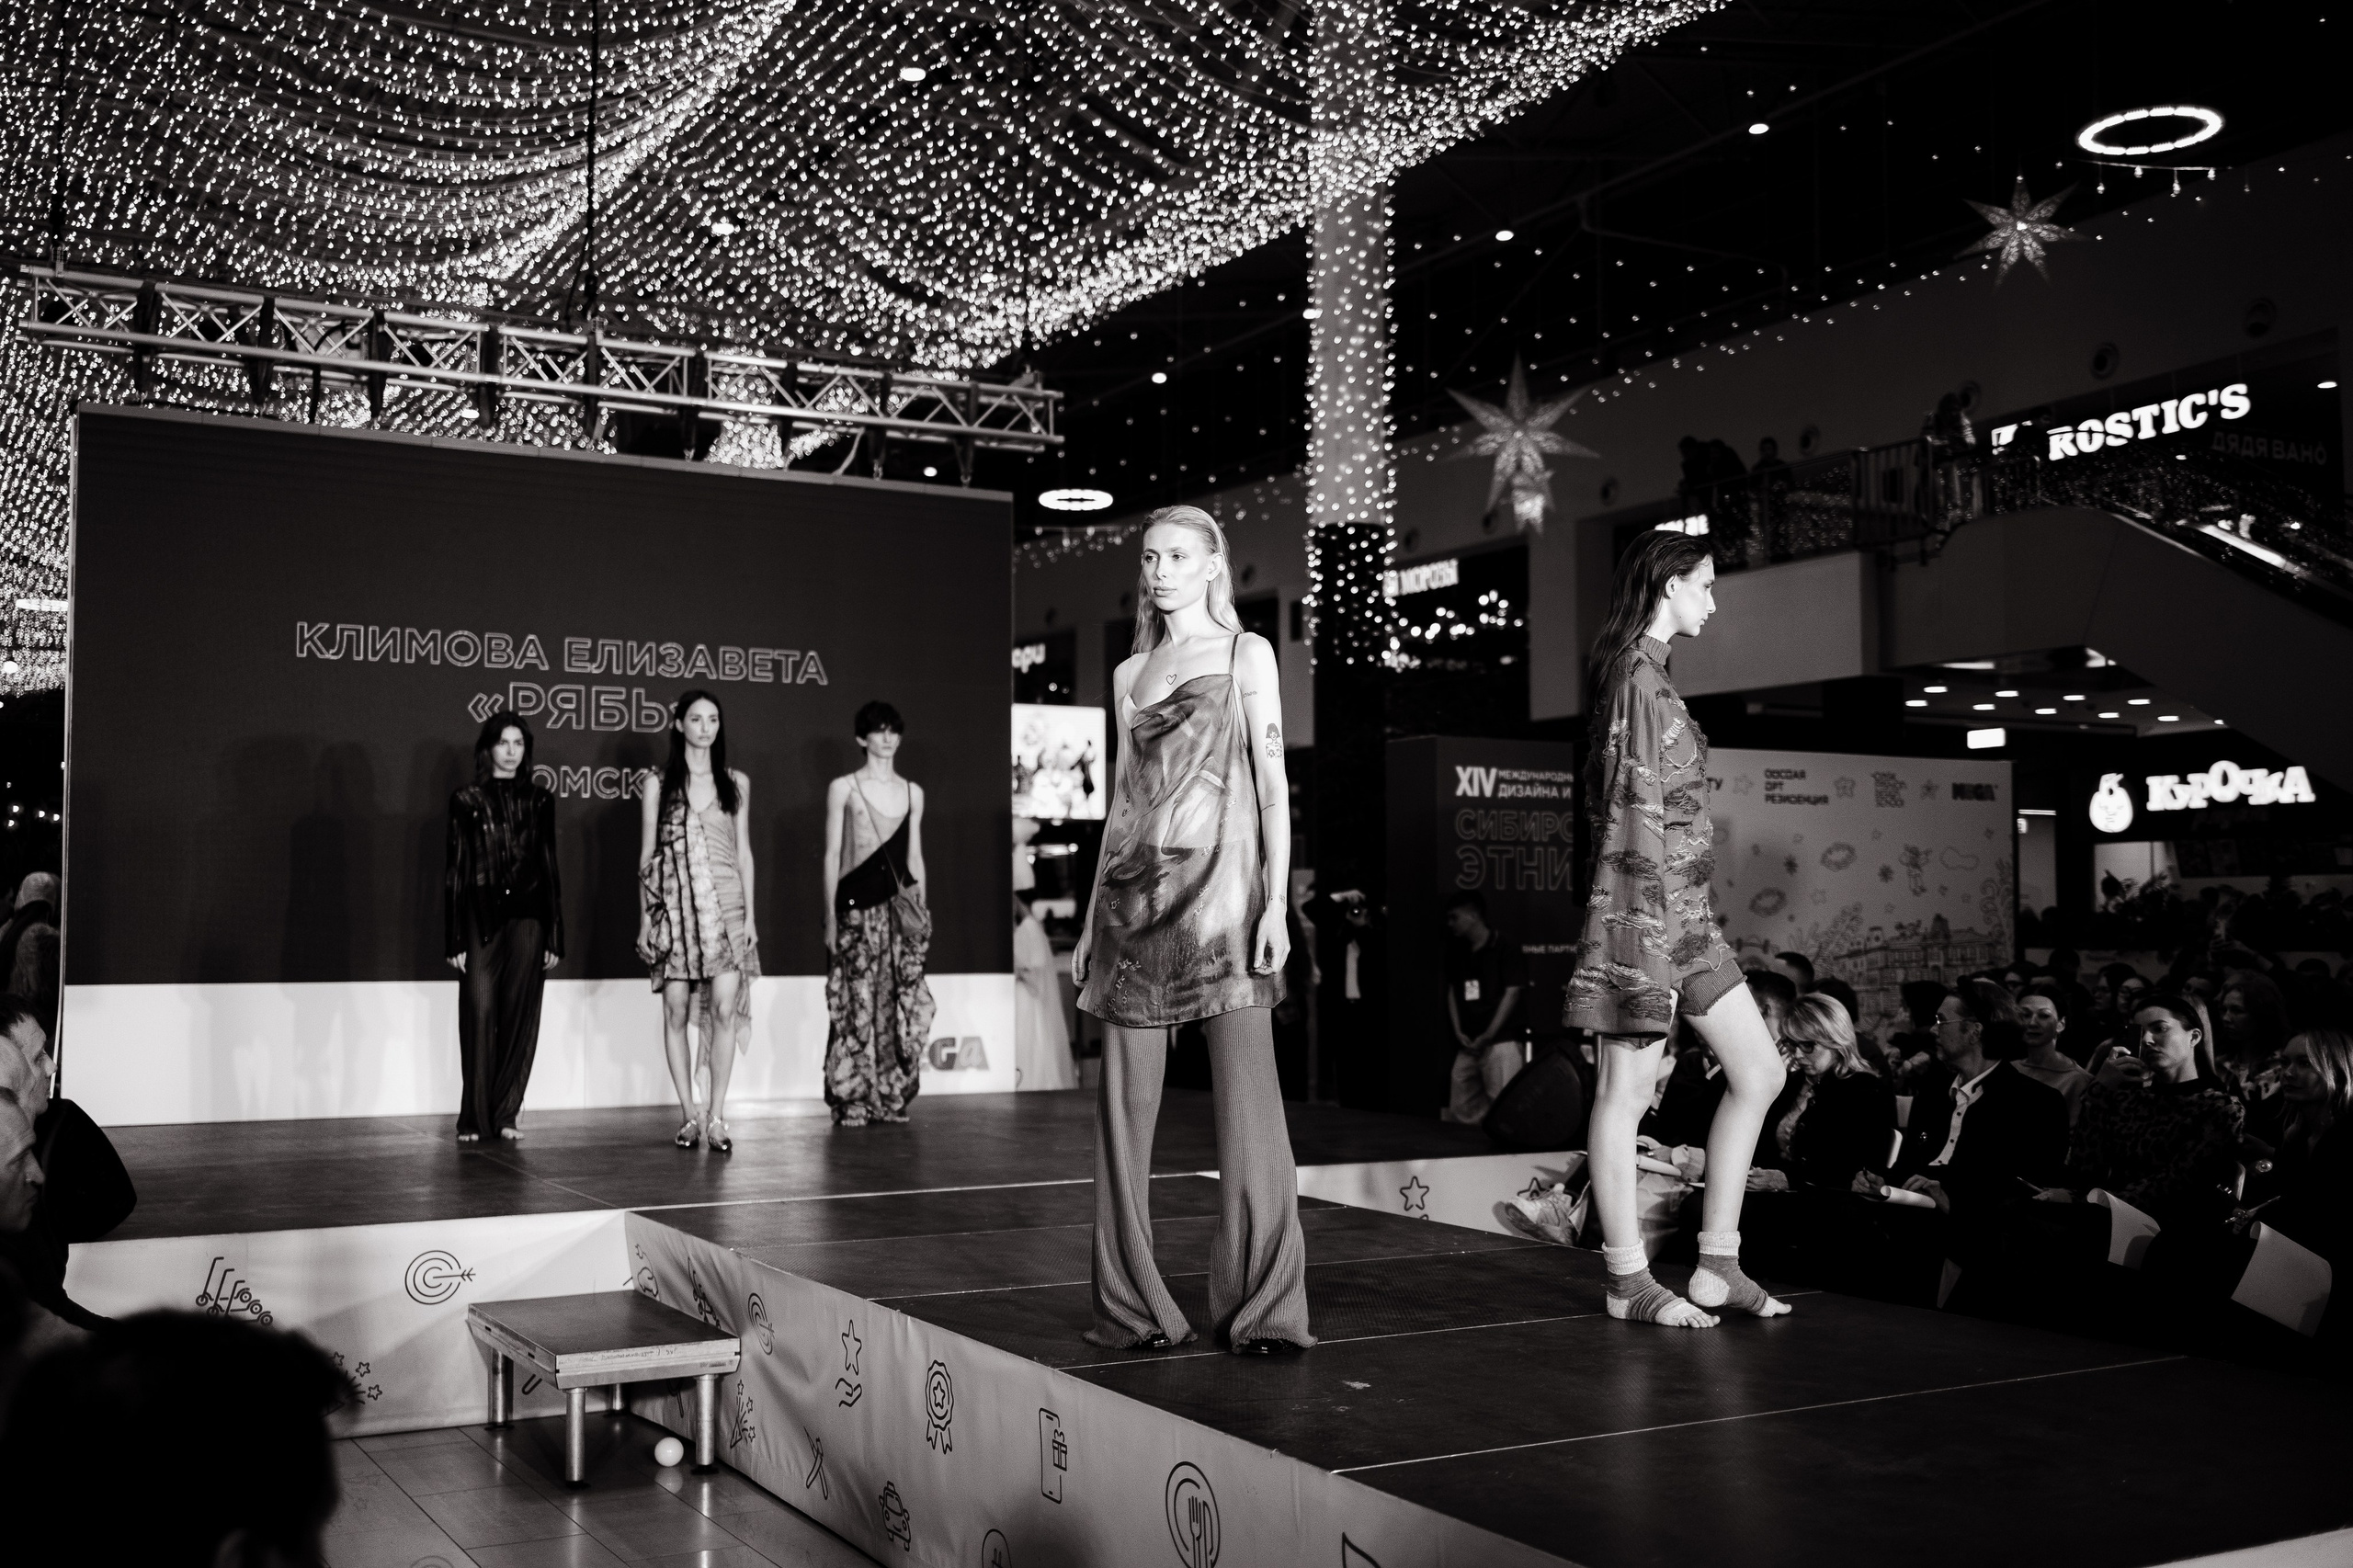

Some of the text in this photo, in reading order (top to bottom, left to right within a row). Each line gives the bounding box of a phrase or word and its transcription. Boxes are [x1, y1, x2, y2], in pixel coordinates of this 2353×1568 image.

[2047, 383, 2251, 460] ROSTIC'S
[2210, 431, 2268, 459] ДЯДЯ
[295, 621, 829, 686] КЛИМОВА ЕЛИЗАВЕТА
[1454, 765, 1497, 798] XIV
[1498, 783, 1559, 799] ДИЗАЙНА
[922, 1036, 990, 1071] GA
